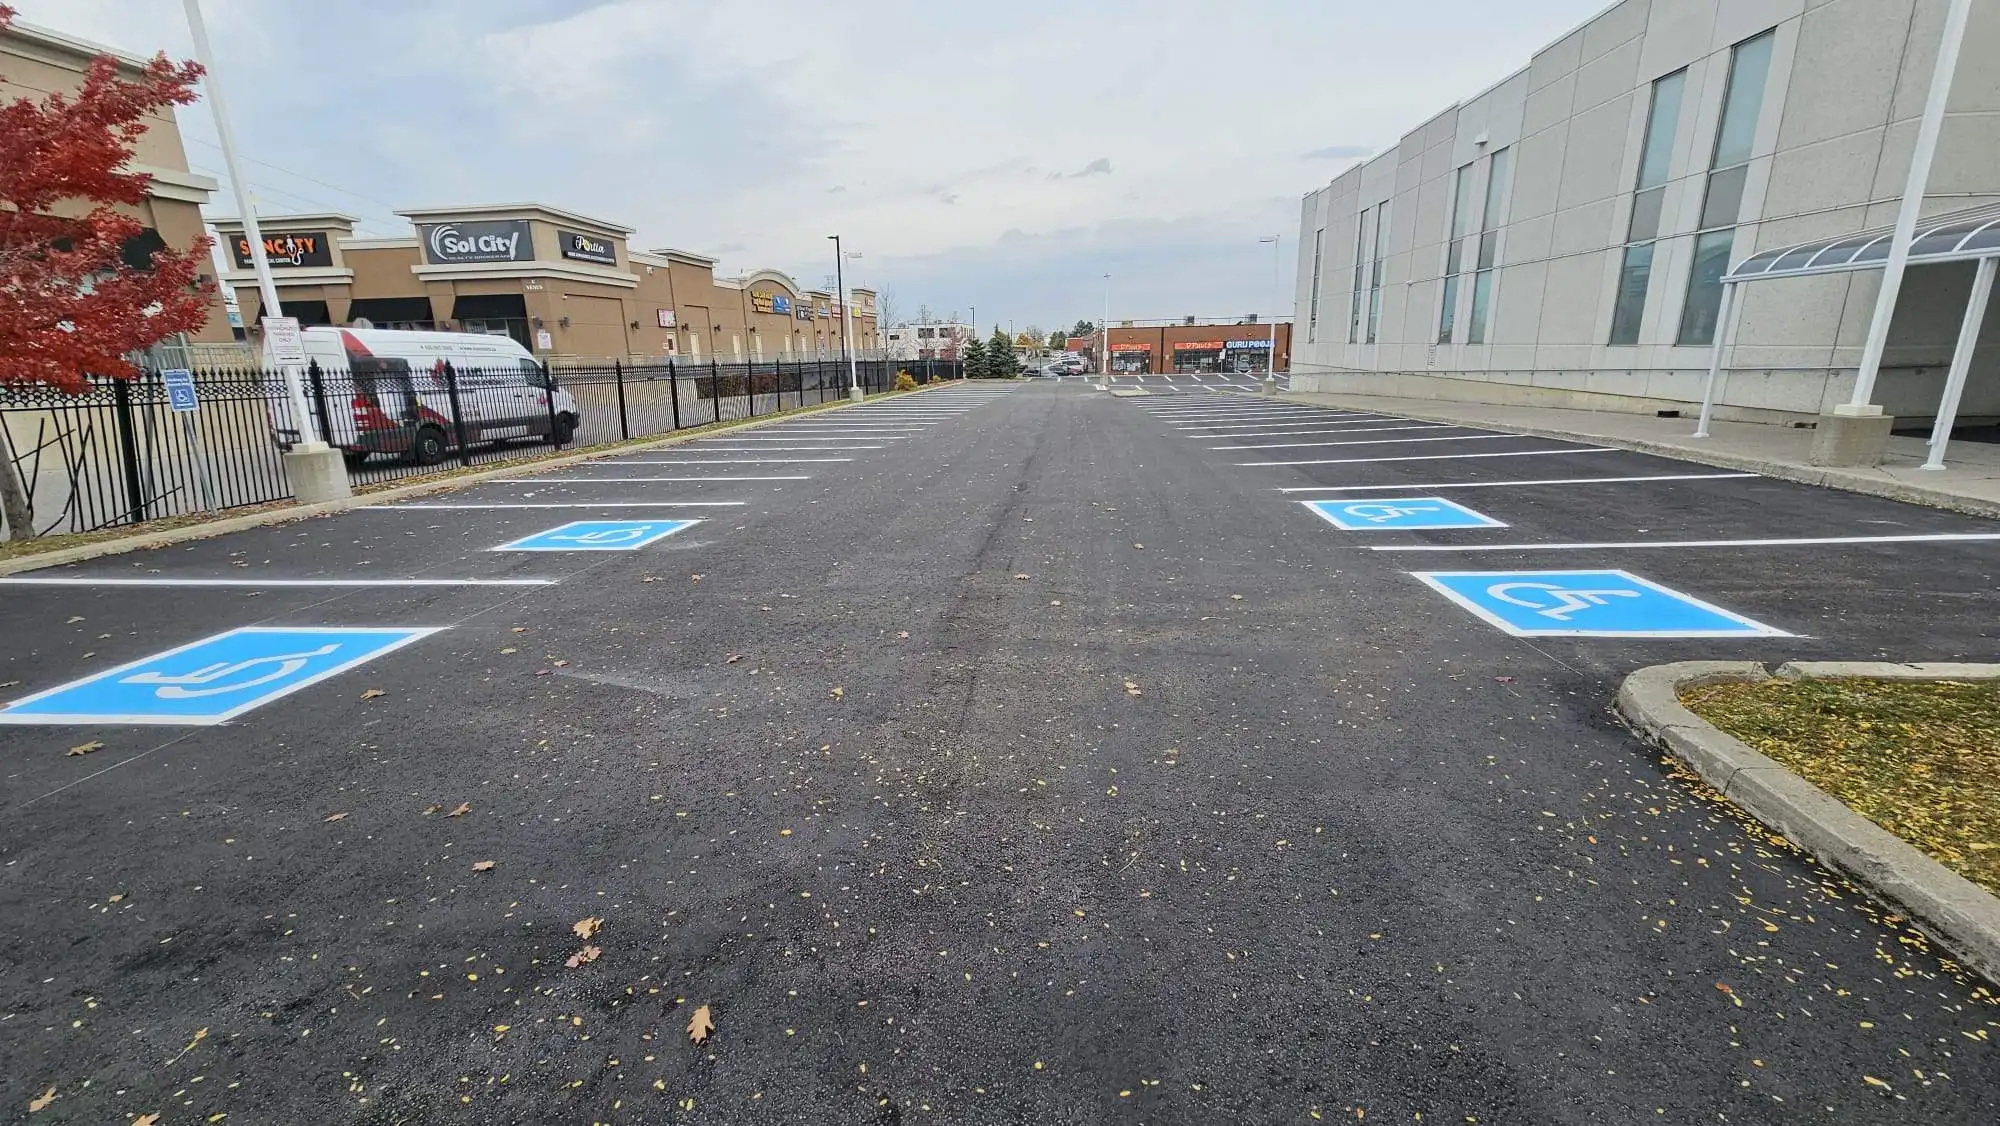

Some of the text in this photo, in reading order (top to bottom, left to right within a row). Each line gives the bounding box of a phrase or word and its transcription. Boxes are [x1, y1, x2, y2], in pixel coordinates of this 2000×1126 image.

[444, 231, 519, 261] Sol City
[1226, 340, 1248, 349] GURU
